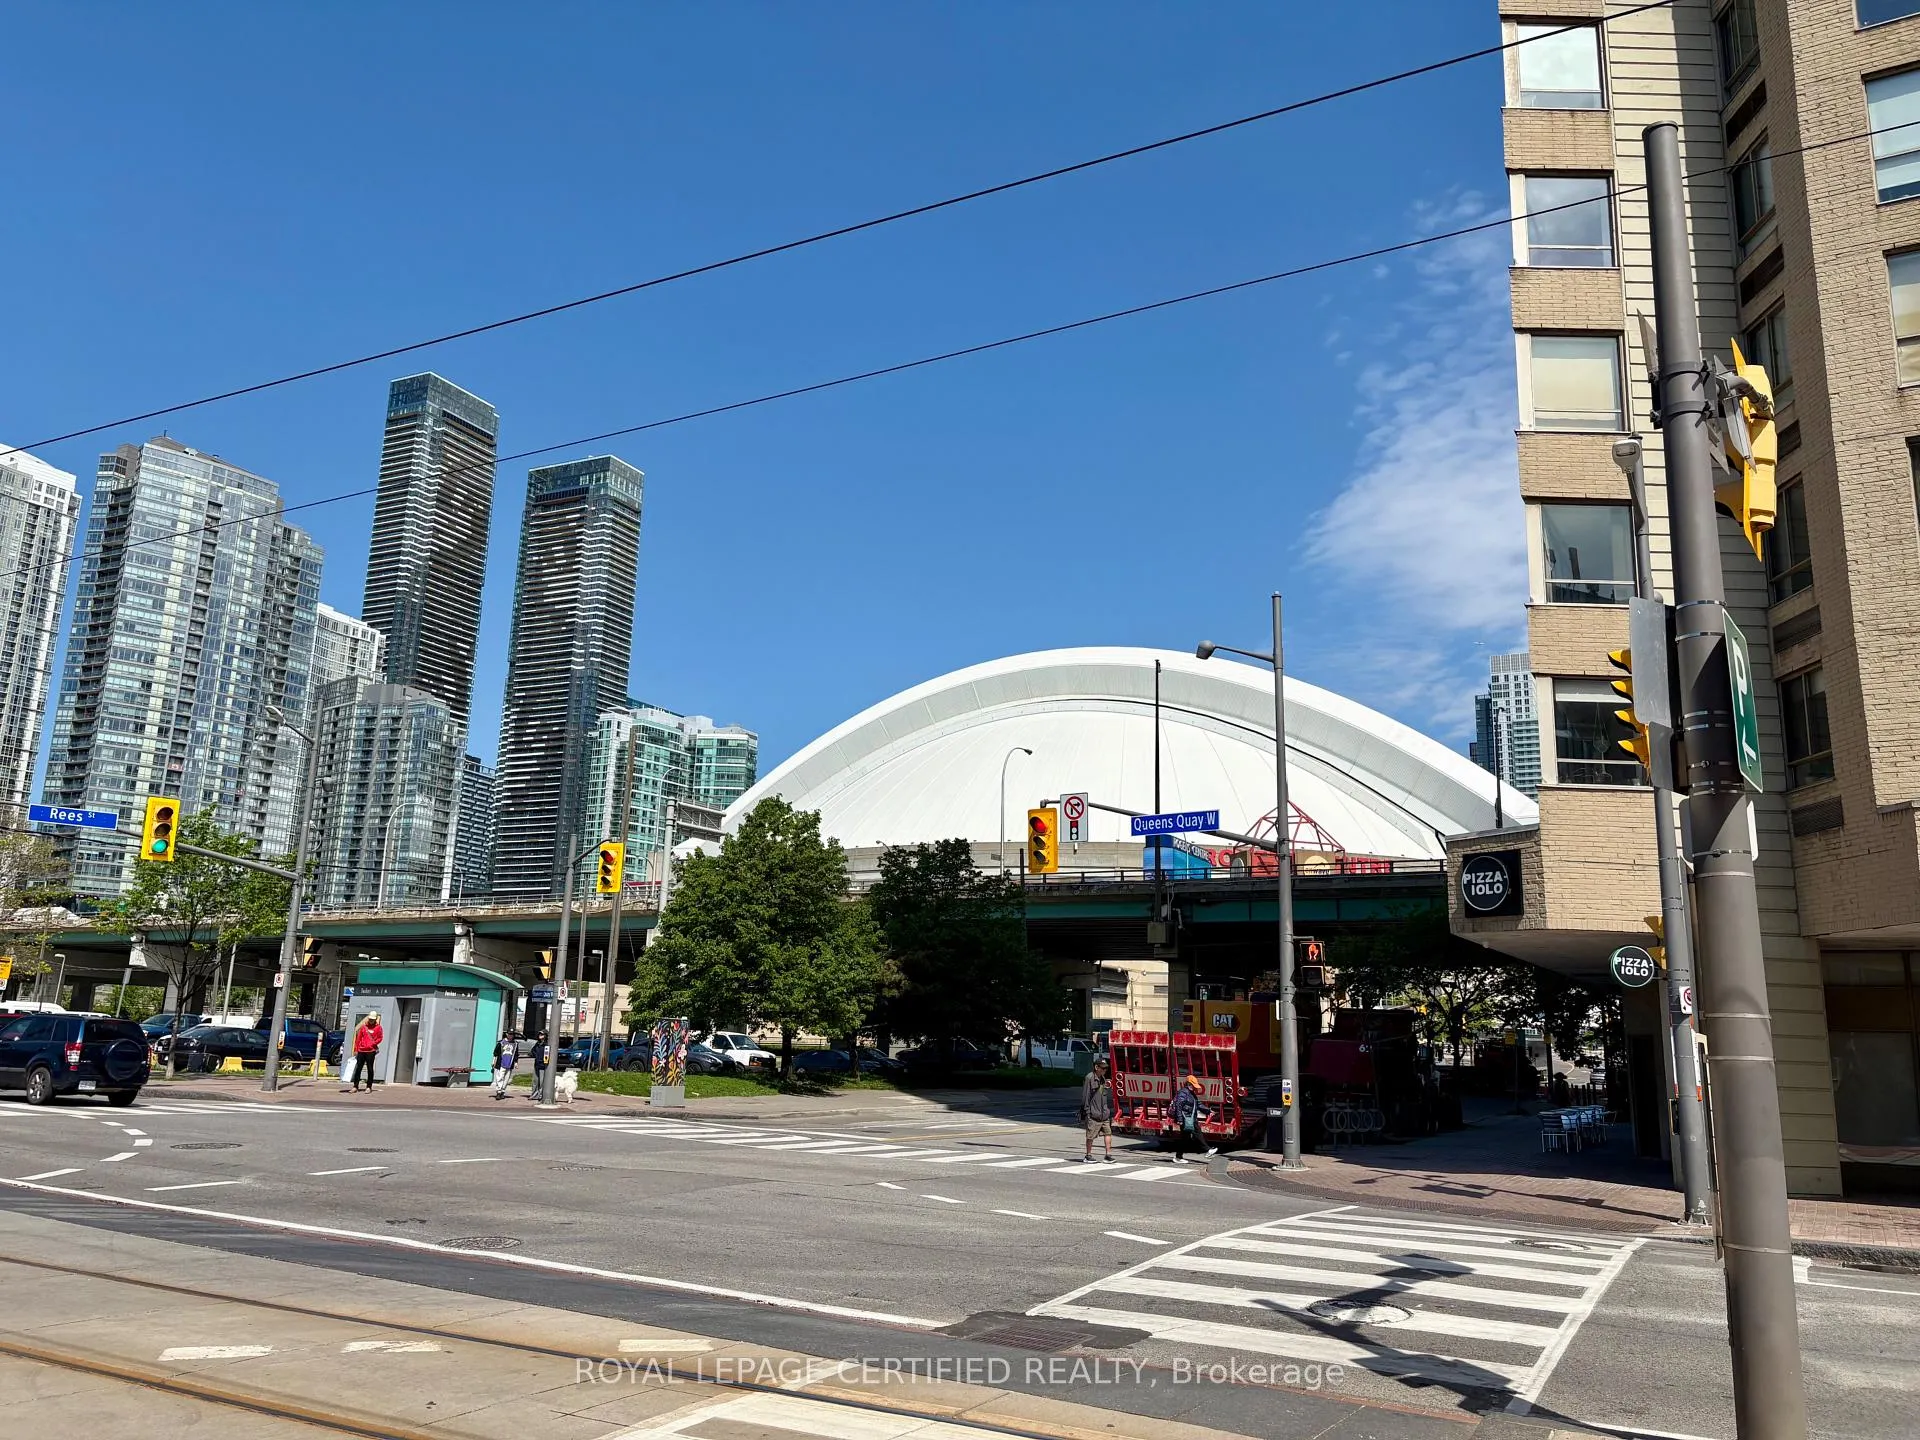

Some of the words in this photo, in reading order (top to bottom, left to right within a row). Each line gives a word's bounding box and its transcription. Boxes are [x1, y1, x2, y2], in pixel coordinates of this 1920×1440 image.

[1731, 637, 1748, 718] P
[49, 808, 83, 822] Rees
[87, 811, 96, 819] St
[1133, 817, 1173, 832] Queens
[1176, 814, 1204, 829] Quay
[1206, 811, 1217, 826] W
[1471, 883, 1503, 896] IOLO
[1621, 966, 1649, 977] IOLO
[1213, 1014, 1233, 1028] CAT
[1142, 1081, 1153, 1093] D
